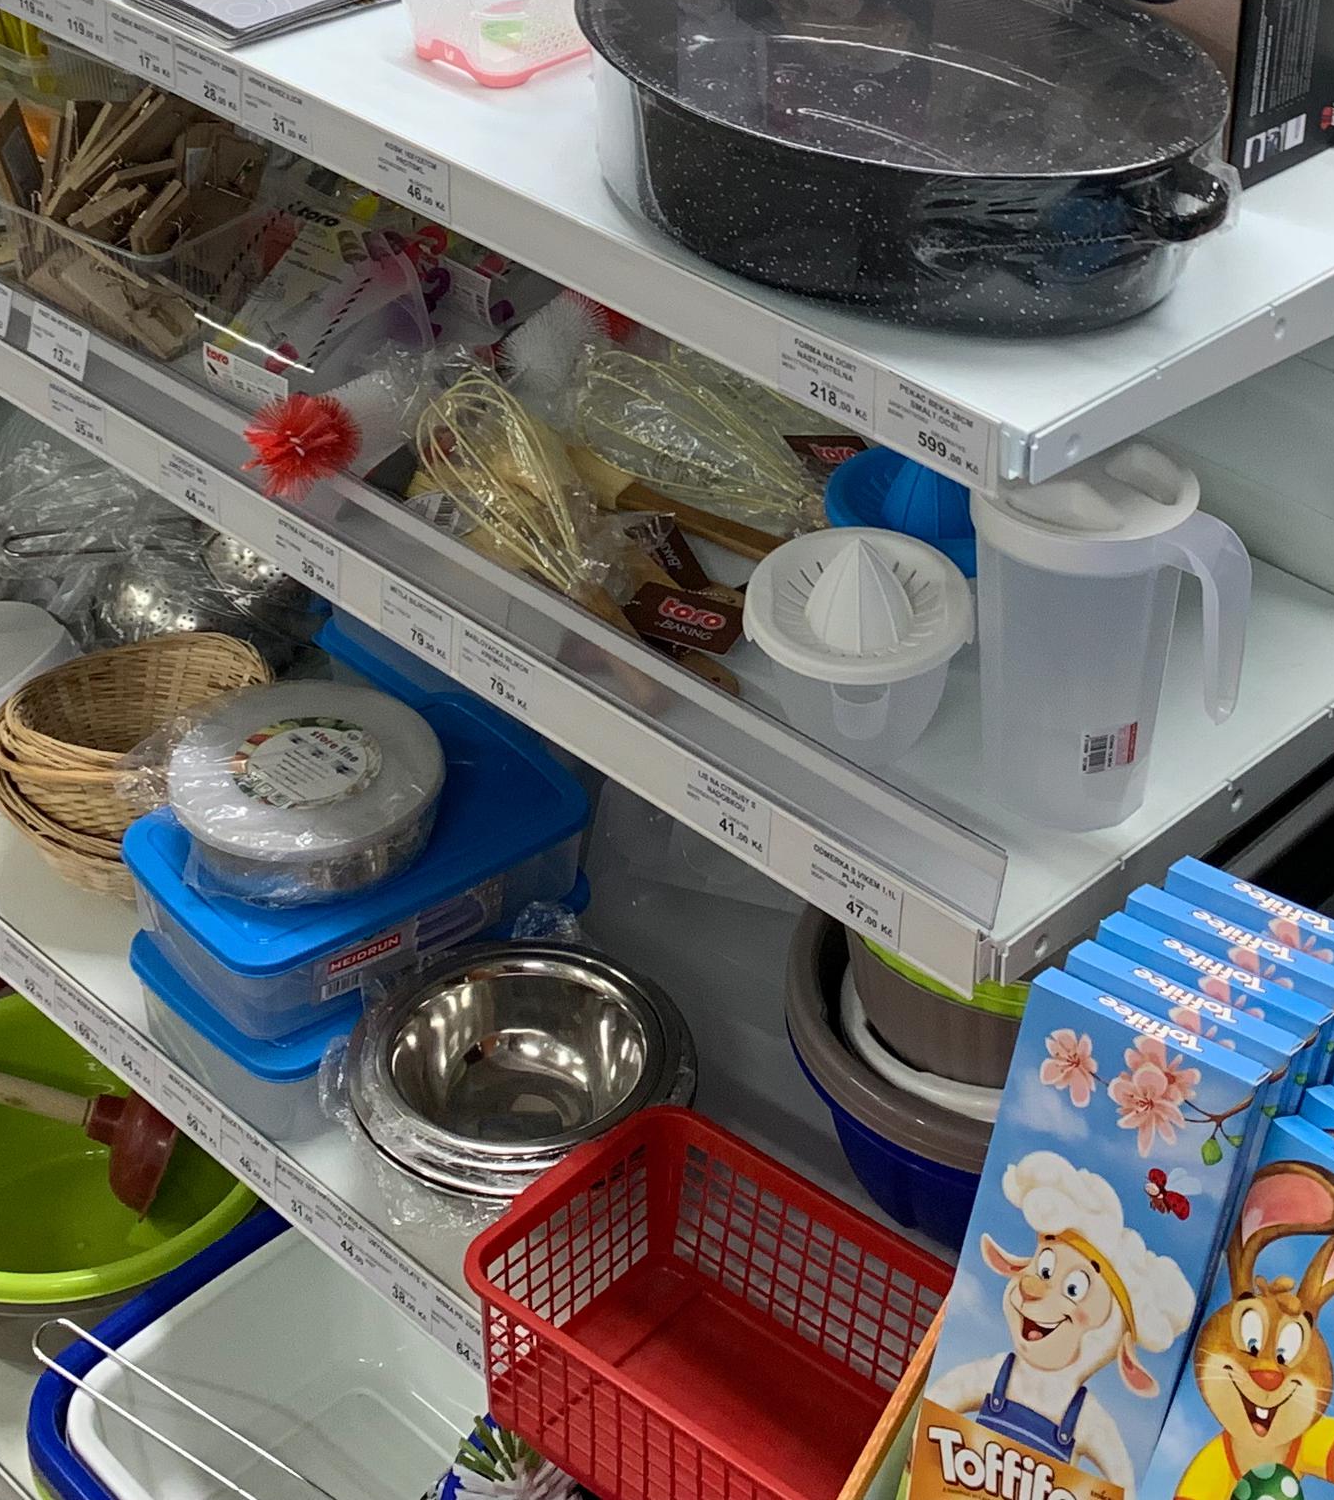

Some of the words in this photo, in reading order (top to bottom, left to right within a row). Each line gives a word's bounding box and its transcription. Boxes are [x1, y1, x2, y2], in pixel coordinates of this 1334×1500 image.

[205, 346, 229, 365] toro
[794, 338, 822, 357] FORMA
[823, 352, 835, 362] NA
[836, 356, 857, 373] DORT
[797, 350, 854, 383] NASTAVITELNA
[659, 597, 726, 630] toro
[660, 620, 713, 640] BAKING
[310, 730, 339, 750] store
[338, 746, 359, 763] line
[698, 770, 709, 781] LIS
[709, 777, 720, 787] NA
[720, 781, 750, 804] CITRUSY
[813, 843, 850, 871] ODMERKA
[851, 867, 856, 875] S
[857, 870, 880, 890] VIKEM
[842, 872, 866, 891] PLAST
[1233, 881, 1334, 934] Toffifee
[329, 936, 400, 972] HEIDRUN
[1192, 910, 1296, 963] Toffifee
[1163, 938, 1266, 994] Toffifee
[1133, 967, 1238, 1024] Toffifee
[1099, 995, 1204, 1053] Toffifee
